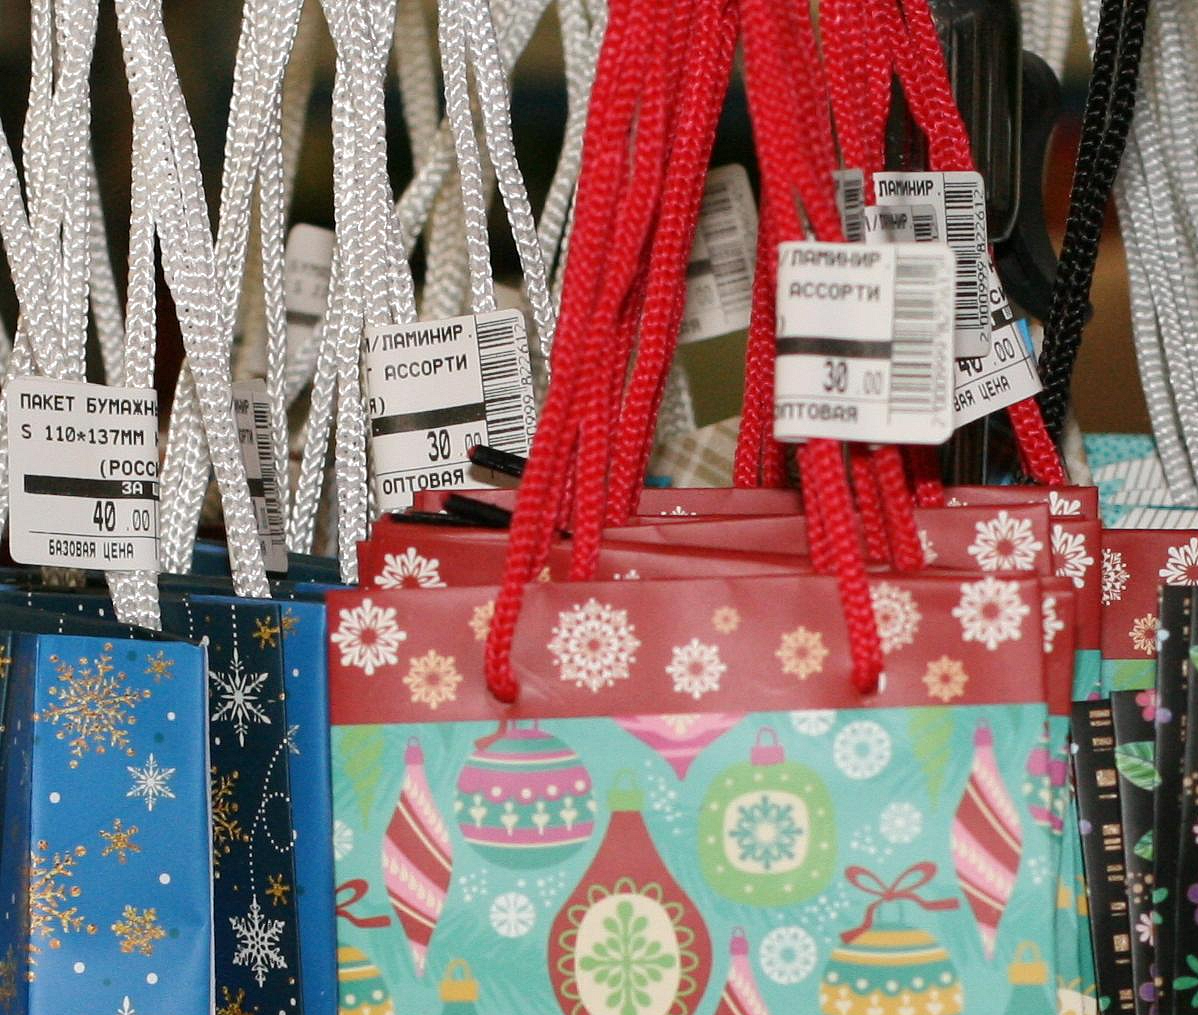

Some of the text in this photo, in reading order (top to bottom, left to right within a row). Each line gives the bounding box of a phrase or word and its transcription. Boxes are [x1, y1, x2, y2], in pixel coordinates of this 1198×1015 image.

[789, 281, 880, 301] АССОРТИ
[384, 354, 468, 382] АССОРТИ
[822, 359, 848, 393] 30
[978, 374, 1012, 403] ЦЕНА
[20, 392, 76, 413] ПАКЕТ
[21, 424, 32, 440] S
[426, 429, 451, 462] 30
[121, 481, 144, 495] ЗА
[382, 468, 465, 495] ОПТОВАЯ
[93, 500, 116, 533] 40
[49, 539, 134, 562] БАЗОВАЯ ЦЕНА
